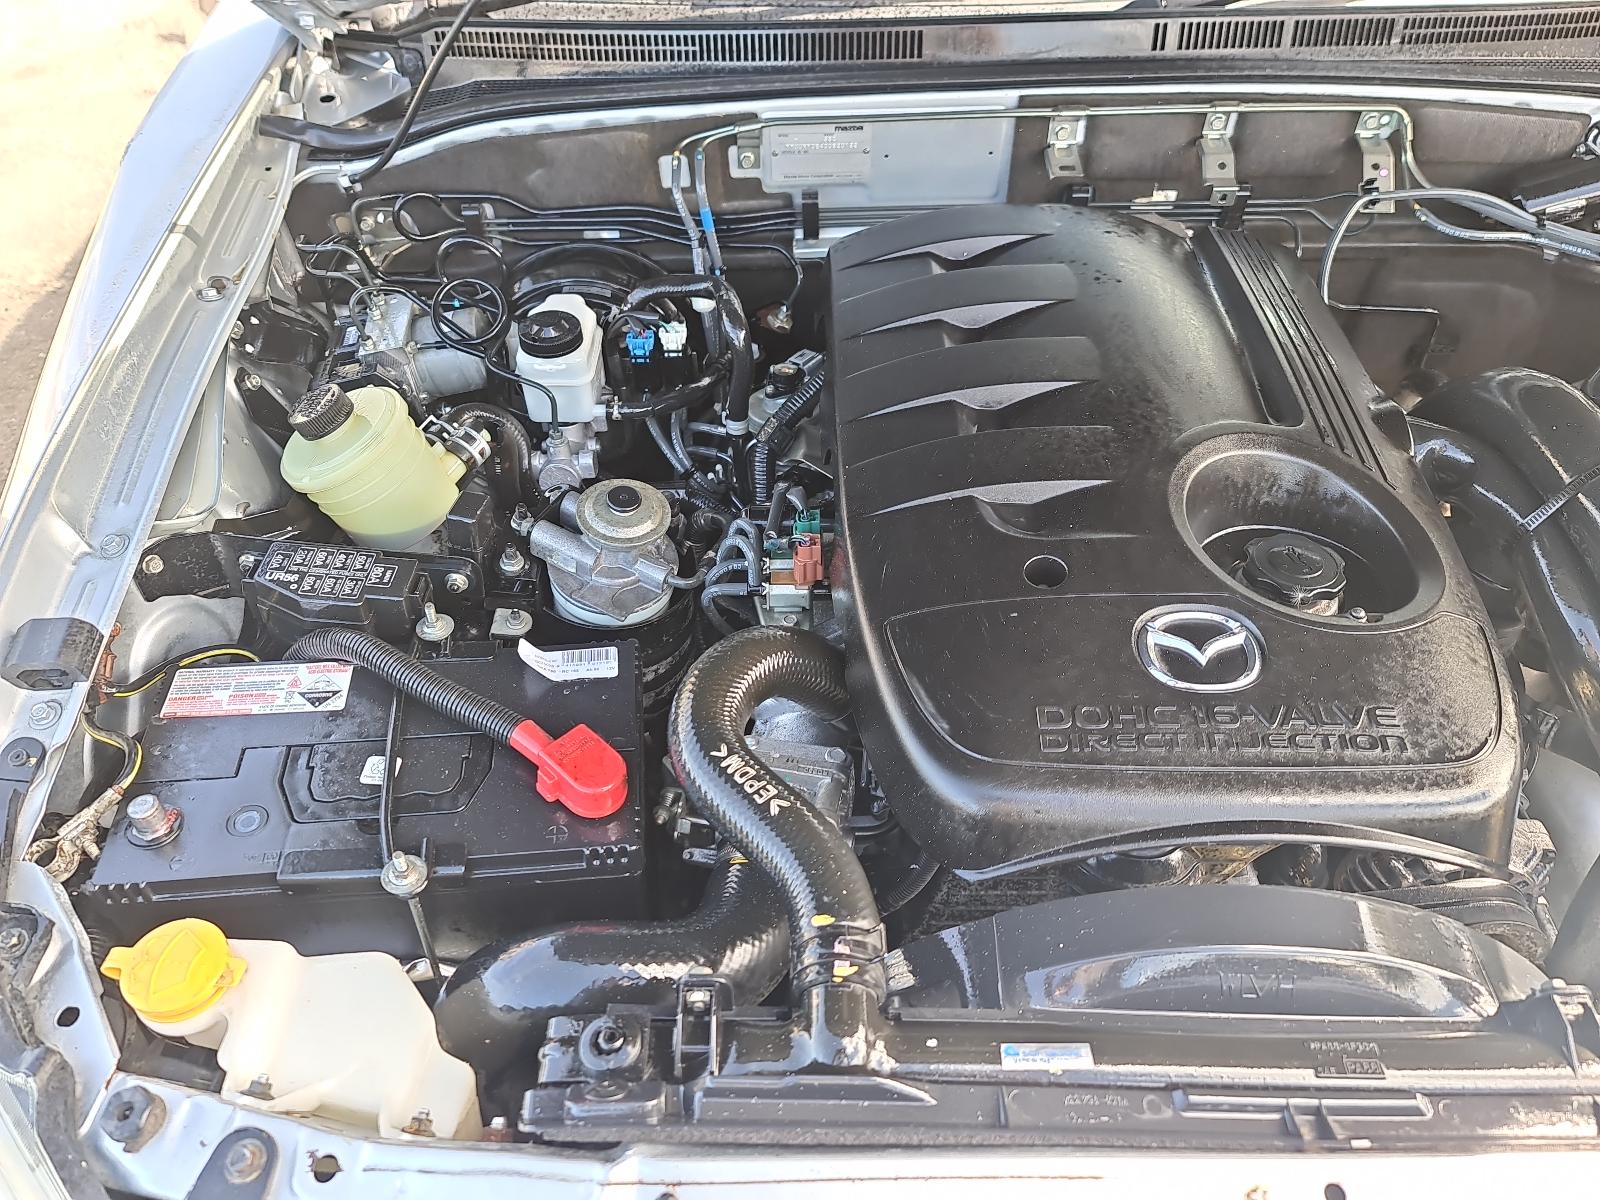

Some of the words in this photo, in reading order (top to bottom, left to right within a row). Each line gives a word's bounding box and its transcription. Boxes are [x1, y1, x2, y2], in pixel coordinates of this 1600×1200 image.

[270, 554, 284, 569] 40A
[293, 550, 307, 564] 20A
[313, 552, 327, 566] 60A
[333, 553, 347, 568] 40A
[353, 555, 367, 570] 60A
[265, 571, 300, 582] UR56
[367, 566, 385, 584] 80A
[301, 576, 316, 591] 60A
[321, 578, 336, 593] 60A
[341, 580, 356, 595] 30A
[1036, 704, 1181, 730] DOHC
[1190, 703, 1403, 730] 16-VALVE
[1039, 733, 1188, 753] DIRECT
[1198, 733, 1410, 754] INJECTION
